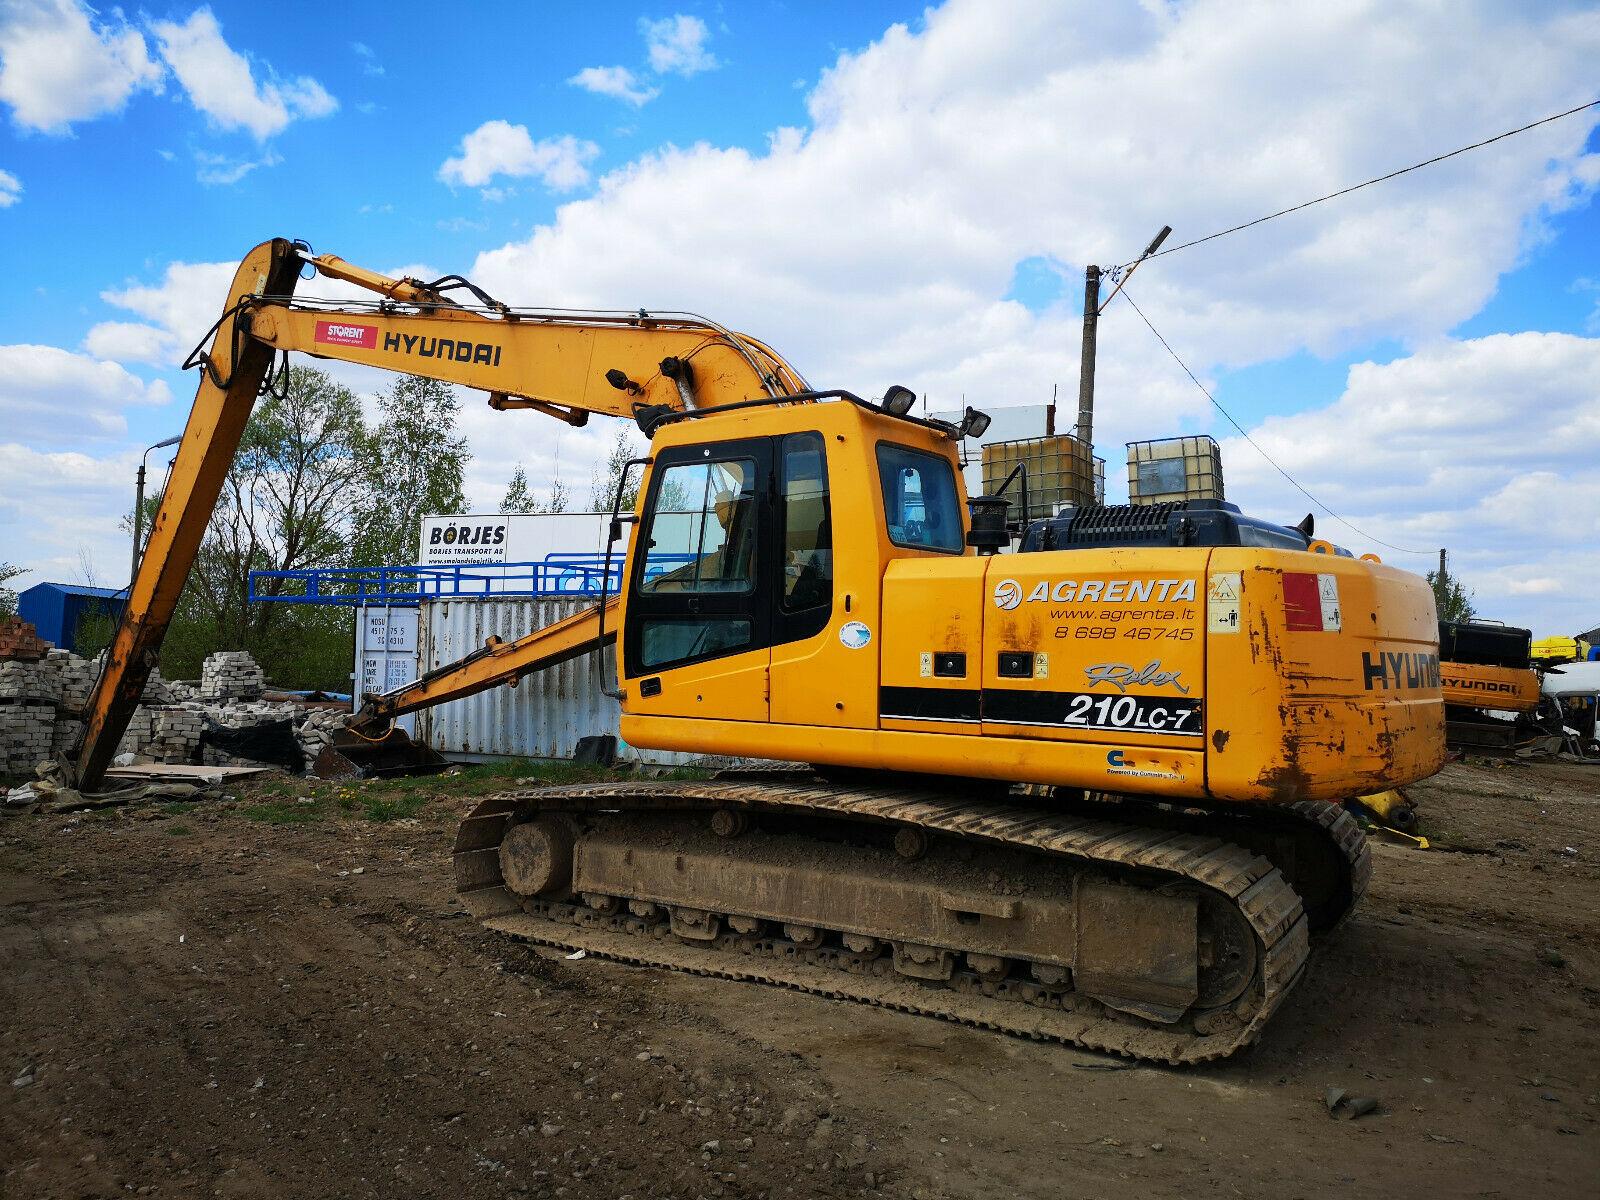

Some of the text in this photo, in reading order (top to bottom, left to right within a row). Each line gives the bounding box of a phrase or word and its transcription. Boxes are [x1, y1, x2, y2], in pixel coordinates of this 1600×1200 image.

[327, 325, 364, 338] STORENT
[384, 331, 502, 367] HYUNDAI
[430, 522, 506, 545] BÖRJES
[1026, 579, 1197, 603] AGRENTA
[1050, 608, 1195, 622] www.agrenta.lt
[1054, 627, 1195, 641] 8 698 46745
